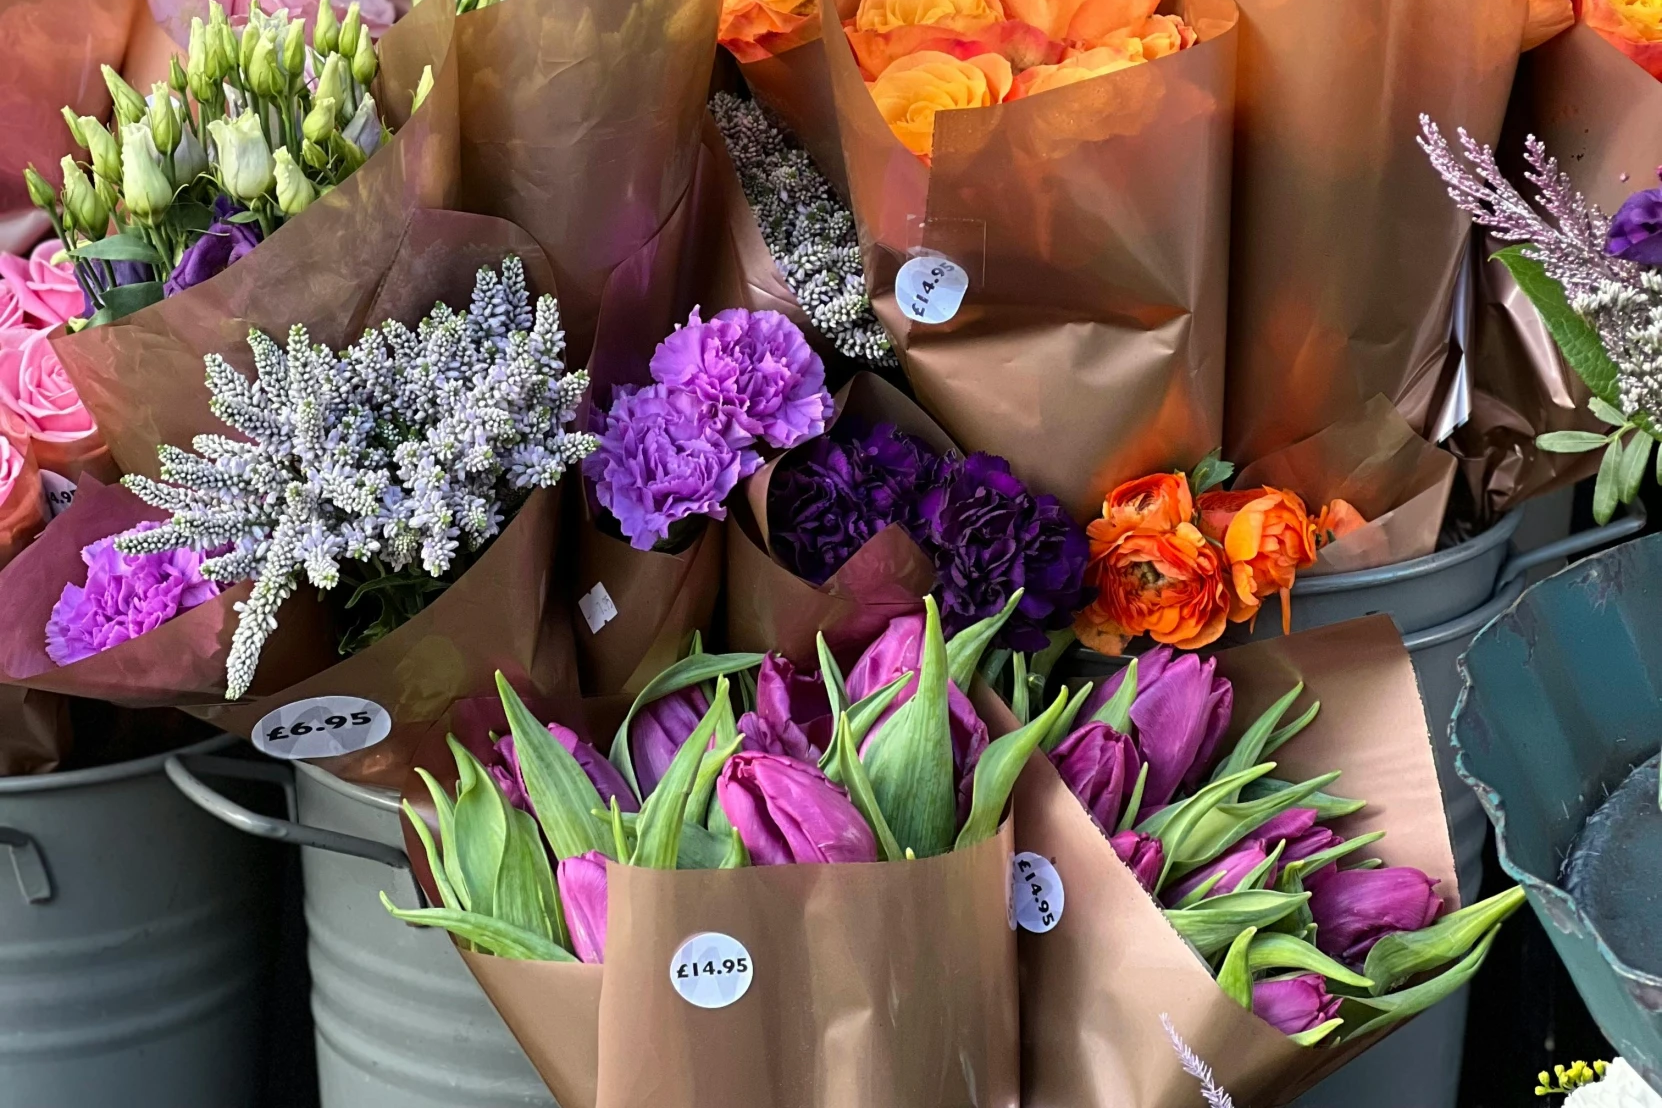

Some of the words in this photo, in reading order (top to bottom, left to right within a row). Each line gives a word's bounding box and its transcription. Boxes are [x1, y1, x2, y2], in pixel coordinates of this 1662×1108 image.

[911, 262, 955, 317] £14.95
[266, 711, 372, 742] £6.95
[1017, 859, 1055, 926] £14.95
[676, 957, 748, 979] £14.95
